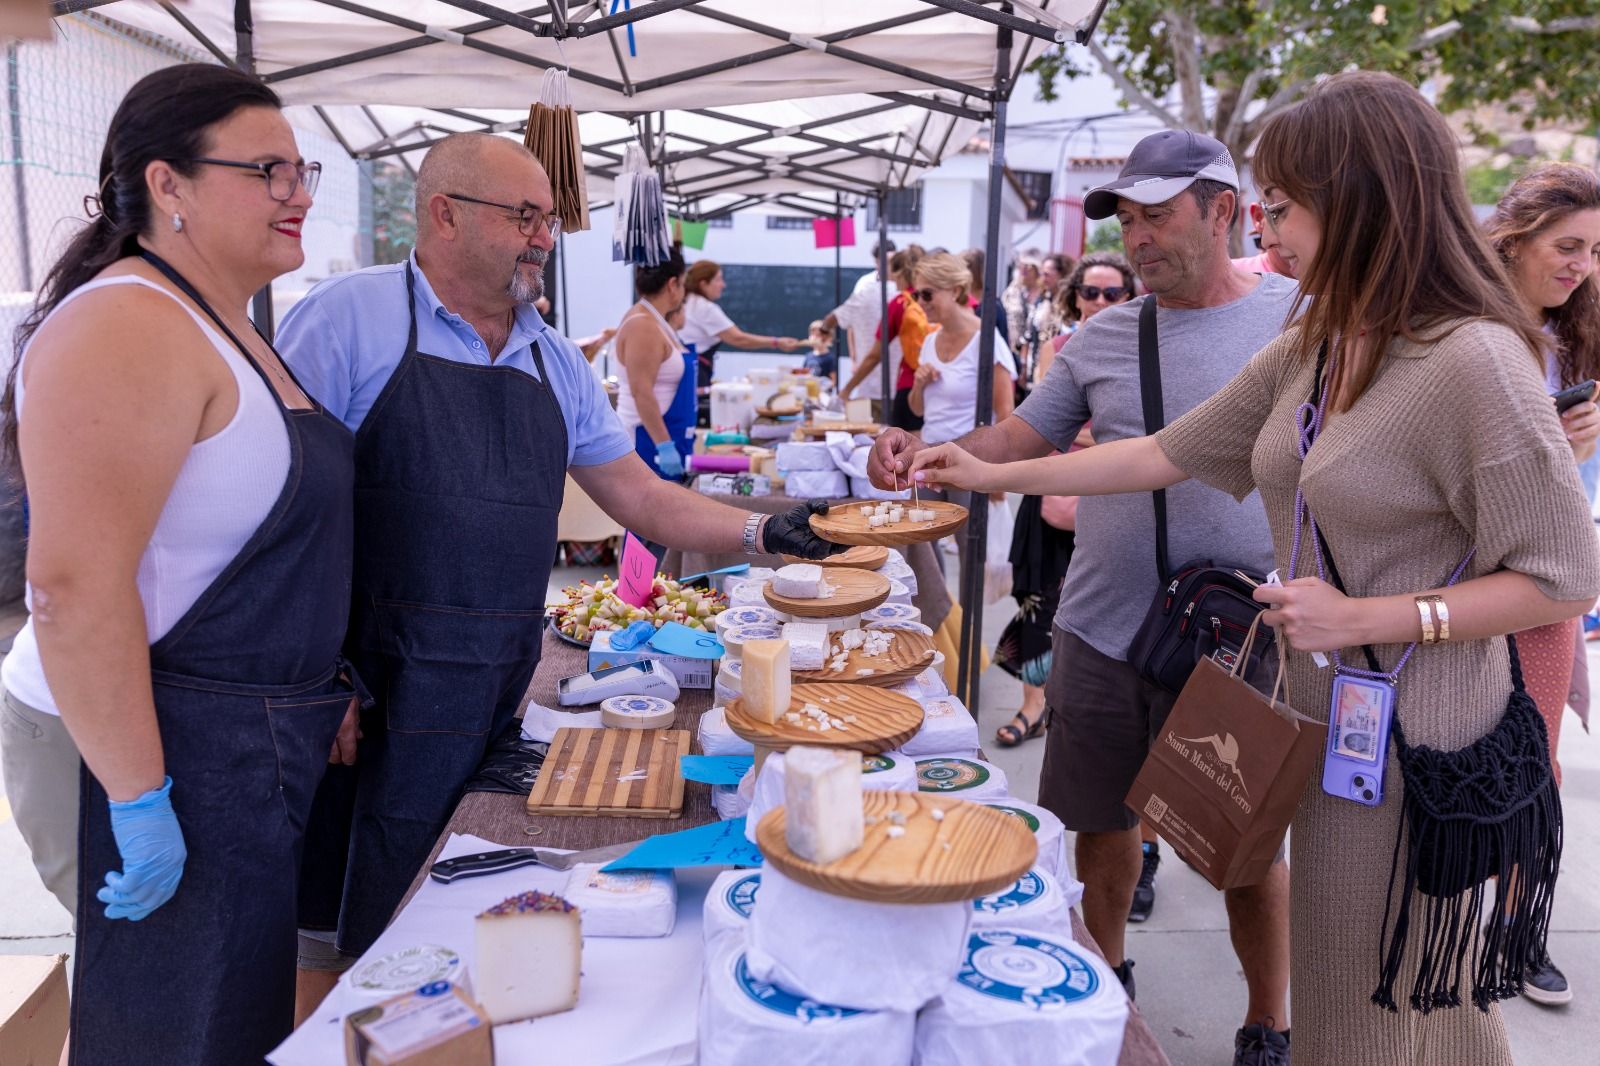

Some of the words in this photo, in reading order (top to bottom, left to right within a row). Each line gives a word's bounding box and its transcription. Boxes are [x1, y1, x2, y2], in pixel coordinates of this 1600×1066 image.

[1165, 730, 1190, 758] Santa
[1216, 772, 1233, 793] del
[1230, 785, 1252, 815] Cerro
